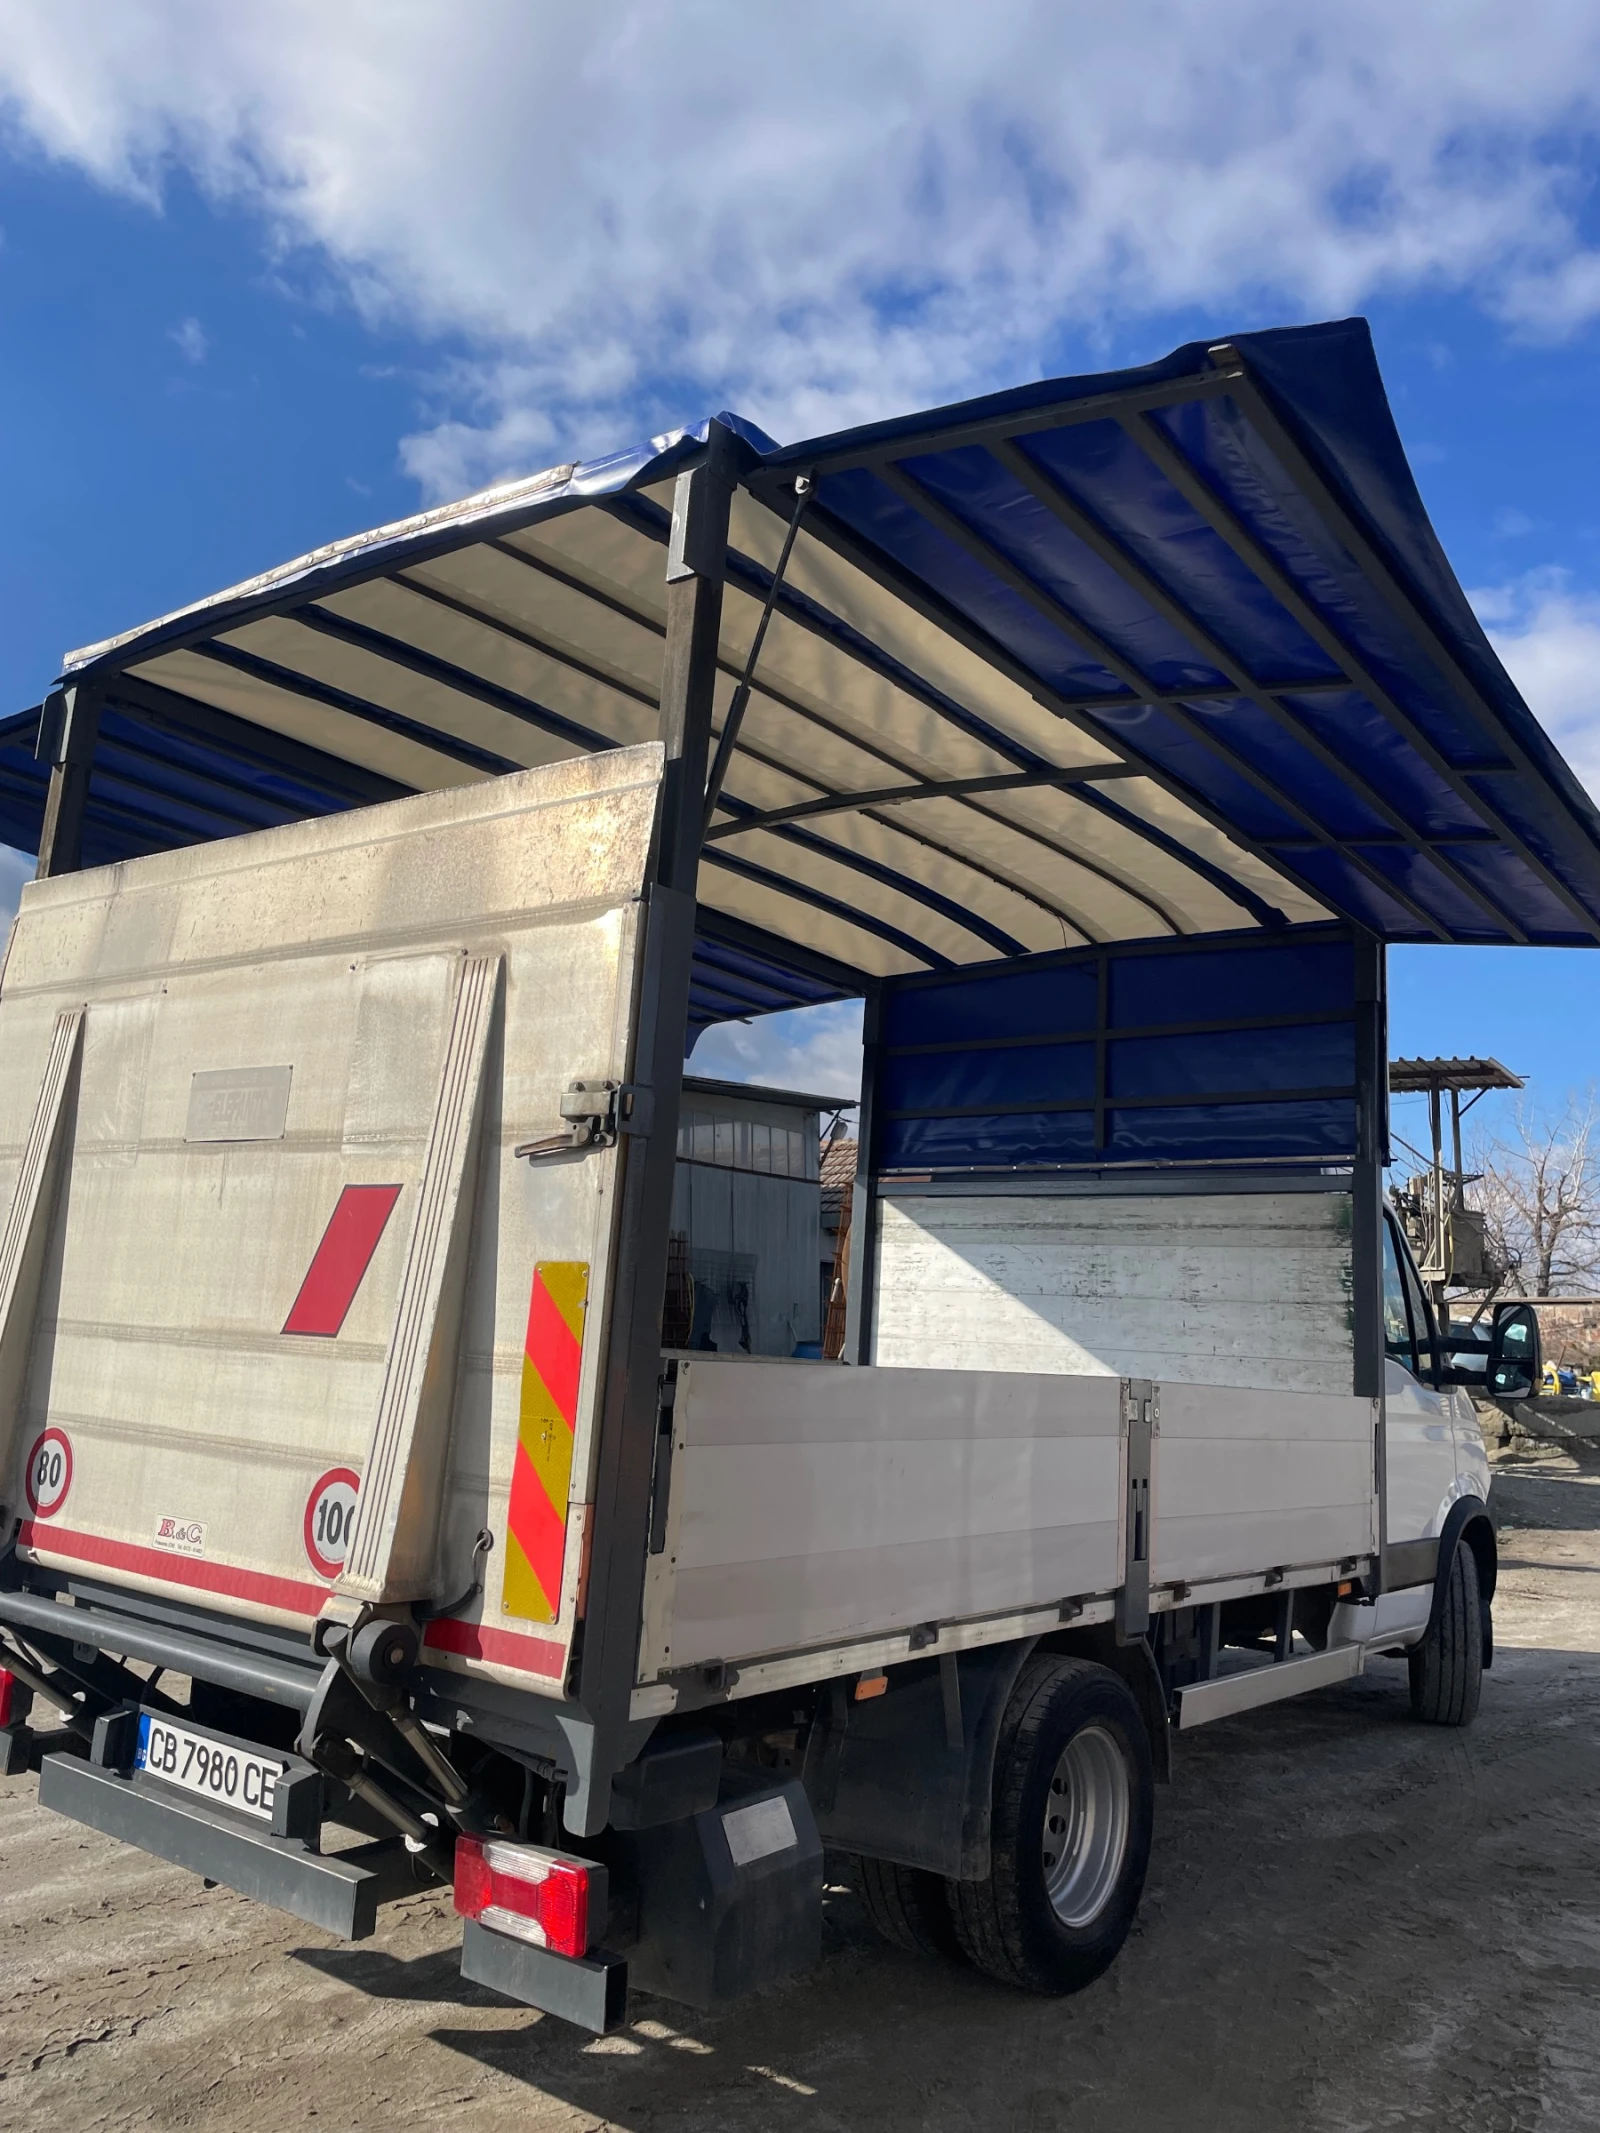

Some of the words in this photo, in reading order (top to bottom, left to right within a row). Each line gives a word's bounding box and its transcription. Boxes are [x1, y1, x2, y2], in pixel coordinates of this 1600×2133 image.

[37, 1450, 61, 1488] 80
[150, 1727, 177, 1774] CB
[181, 1738, 239, 1797] 7980
[243, 1762, 279, 1812] CE
